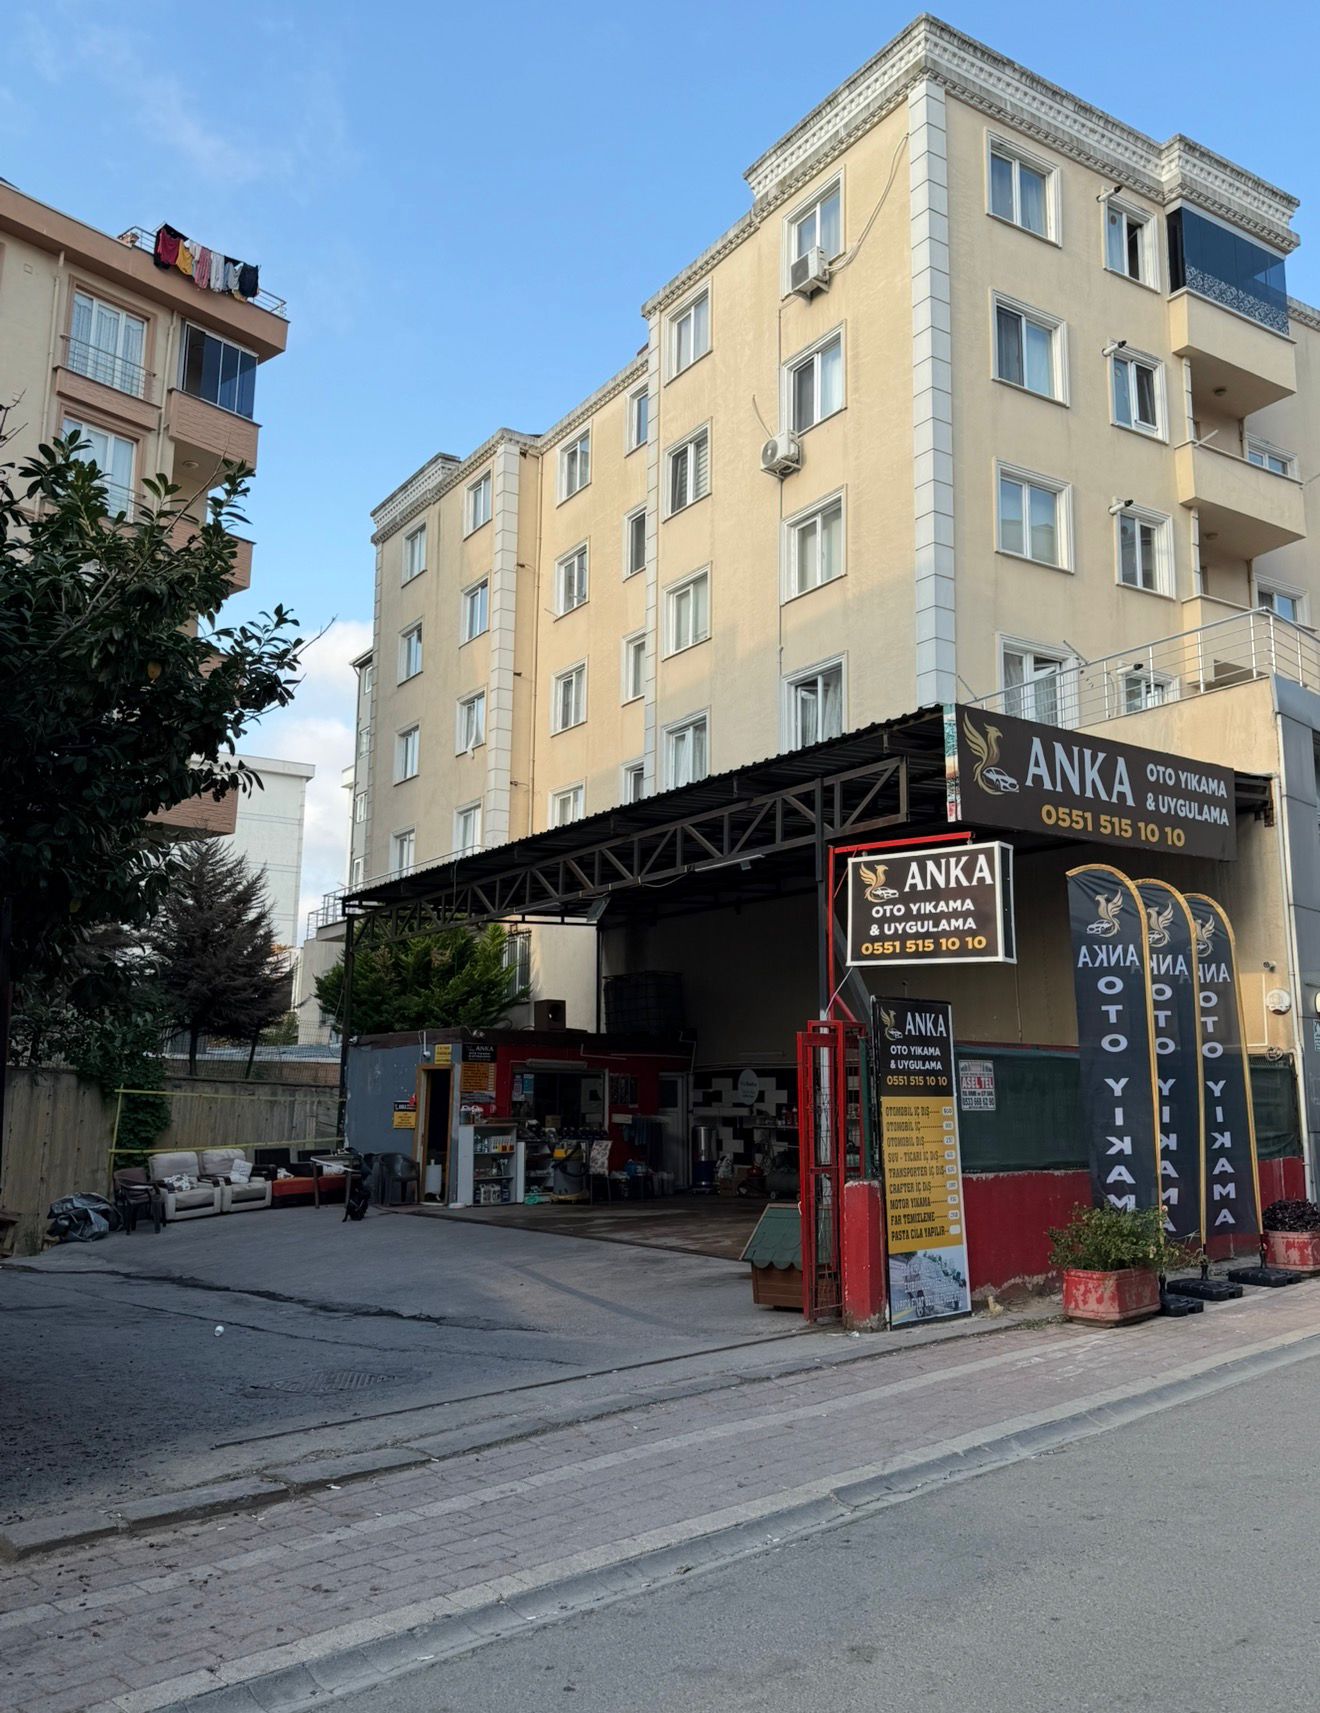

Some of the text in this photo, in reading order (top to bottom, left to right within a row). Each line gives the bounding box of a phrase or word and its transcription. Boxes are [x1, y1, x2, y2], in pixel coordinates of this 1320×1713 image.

[1024, 736, 1136, 807] ANKA
[1146, 763, 1228, 799] OTO YIKAMA
[1146, 792, 1230, 826] & UYGULAMA
[1041, 804, 1186, 847] 0551 515 10 10
[904, 854, 994, 892] ANKA
[871, 898, 975, 918] OTO YIKAMA
[869, 917, 977, 936] & UYGULAMA
[861, 936, 987, 955] 0551 515 10 10
[905, 1011, 947, 1037] ANKA
[890, 1045, 941, 1056] OTO YIKAMA
[890, 1059, 943, 1070] & UYGULAMA
[886, 1075, 948, 1086] 0551 515 10 10
[890, 1197, 910, 1210] MOTOR
[891, 1229, 910, 1242] PASTA
